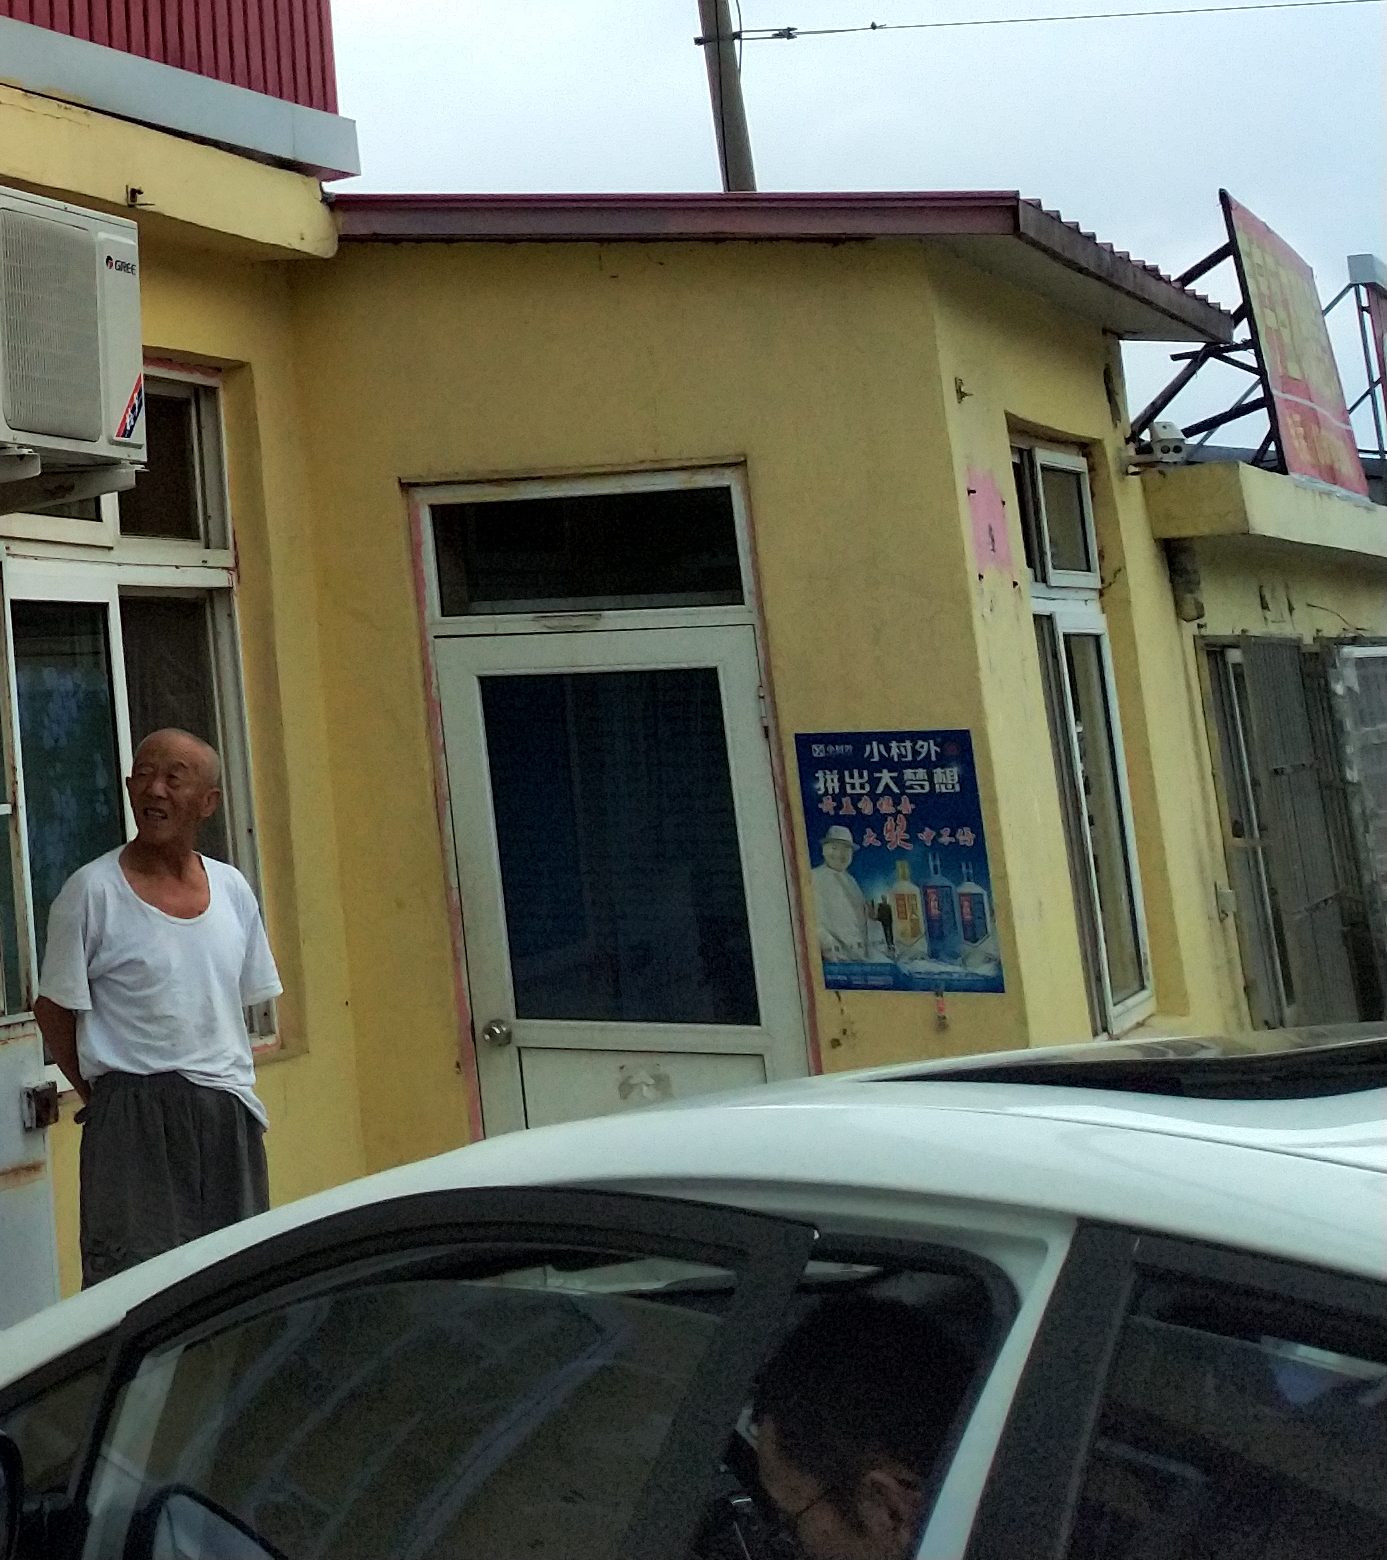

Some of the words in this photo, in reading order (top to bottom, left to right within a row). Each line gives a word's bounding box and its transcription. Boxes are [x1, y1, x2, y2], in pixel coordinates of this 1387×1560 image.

[114, 260, 136, 276] GREE
[864, 740, 940, 762] 小村外
[815, 768, 960, 794] 拼出大梦想
